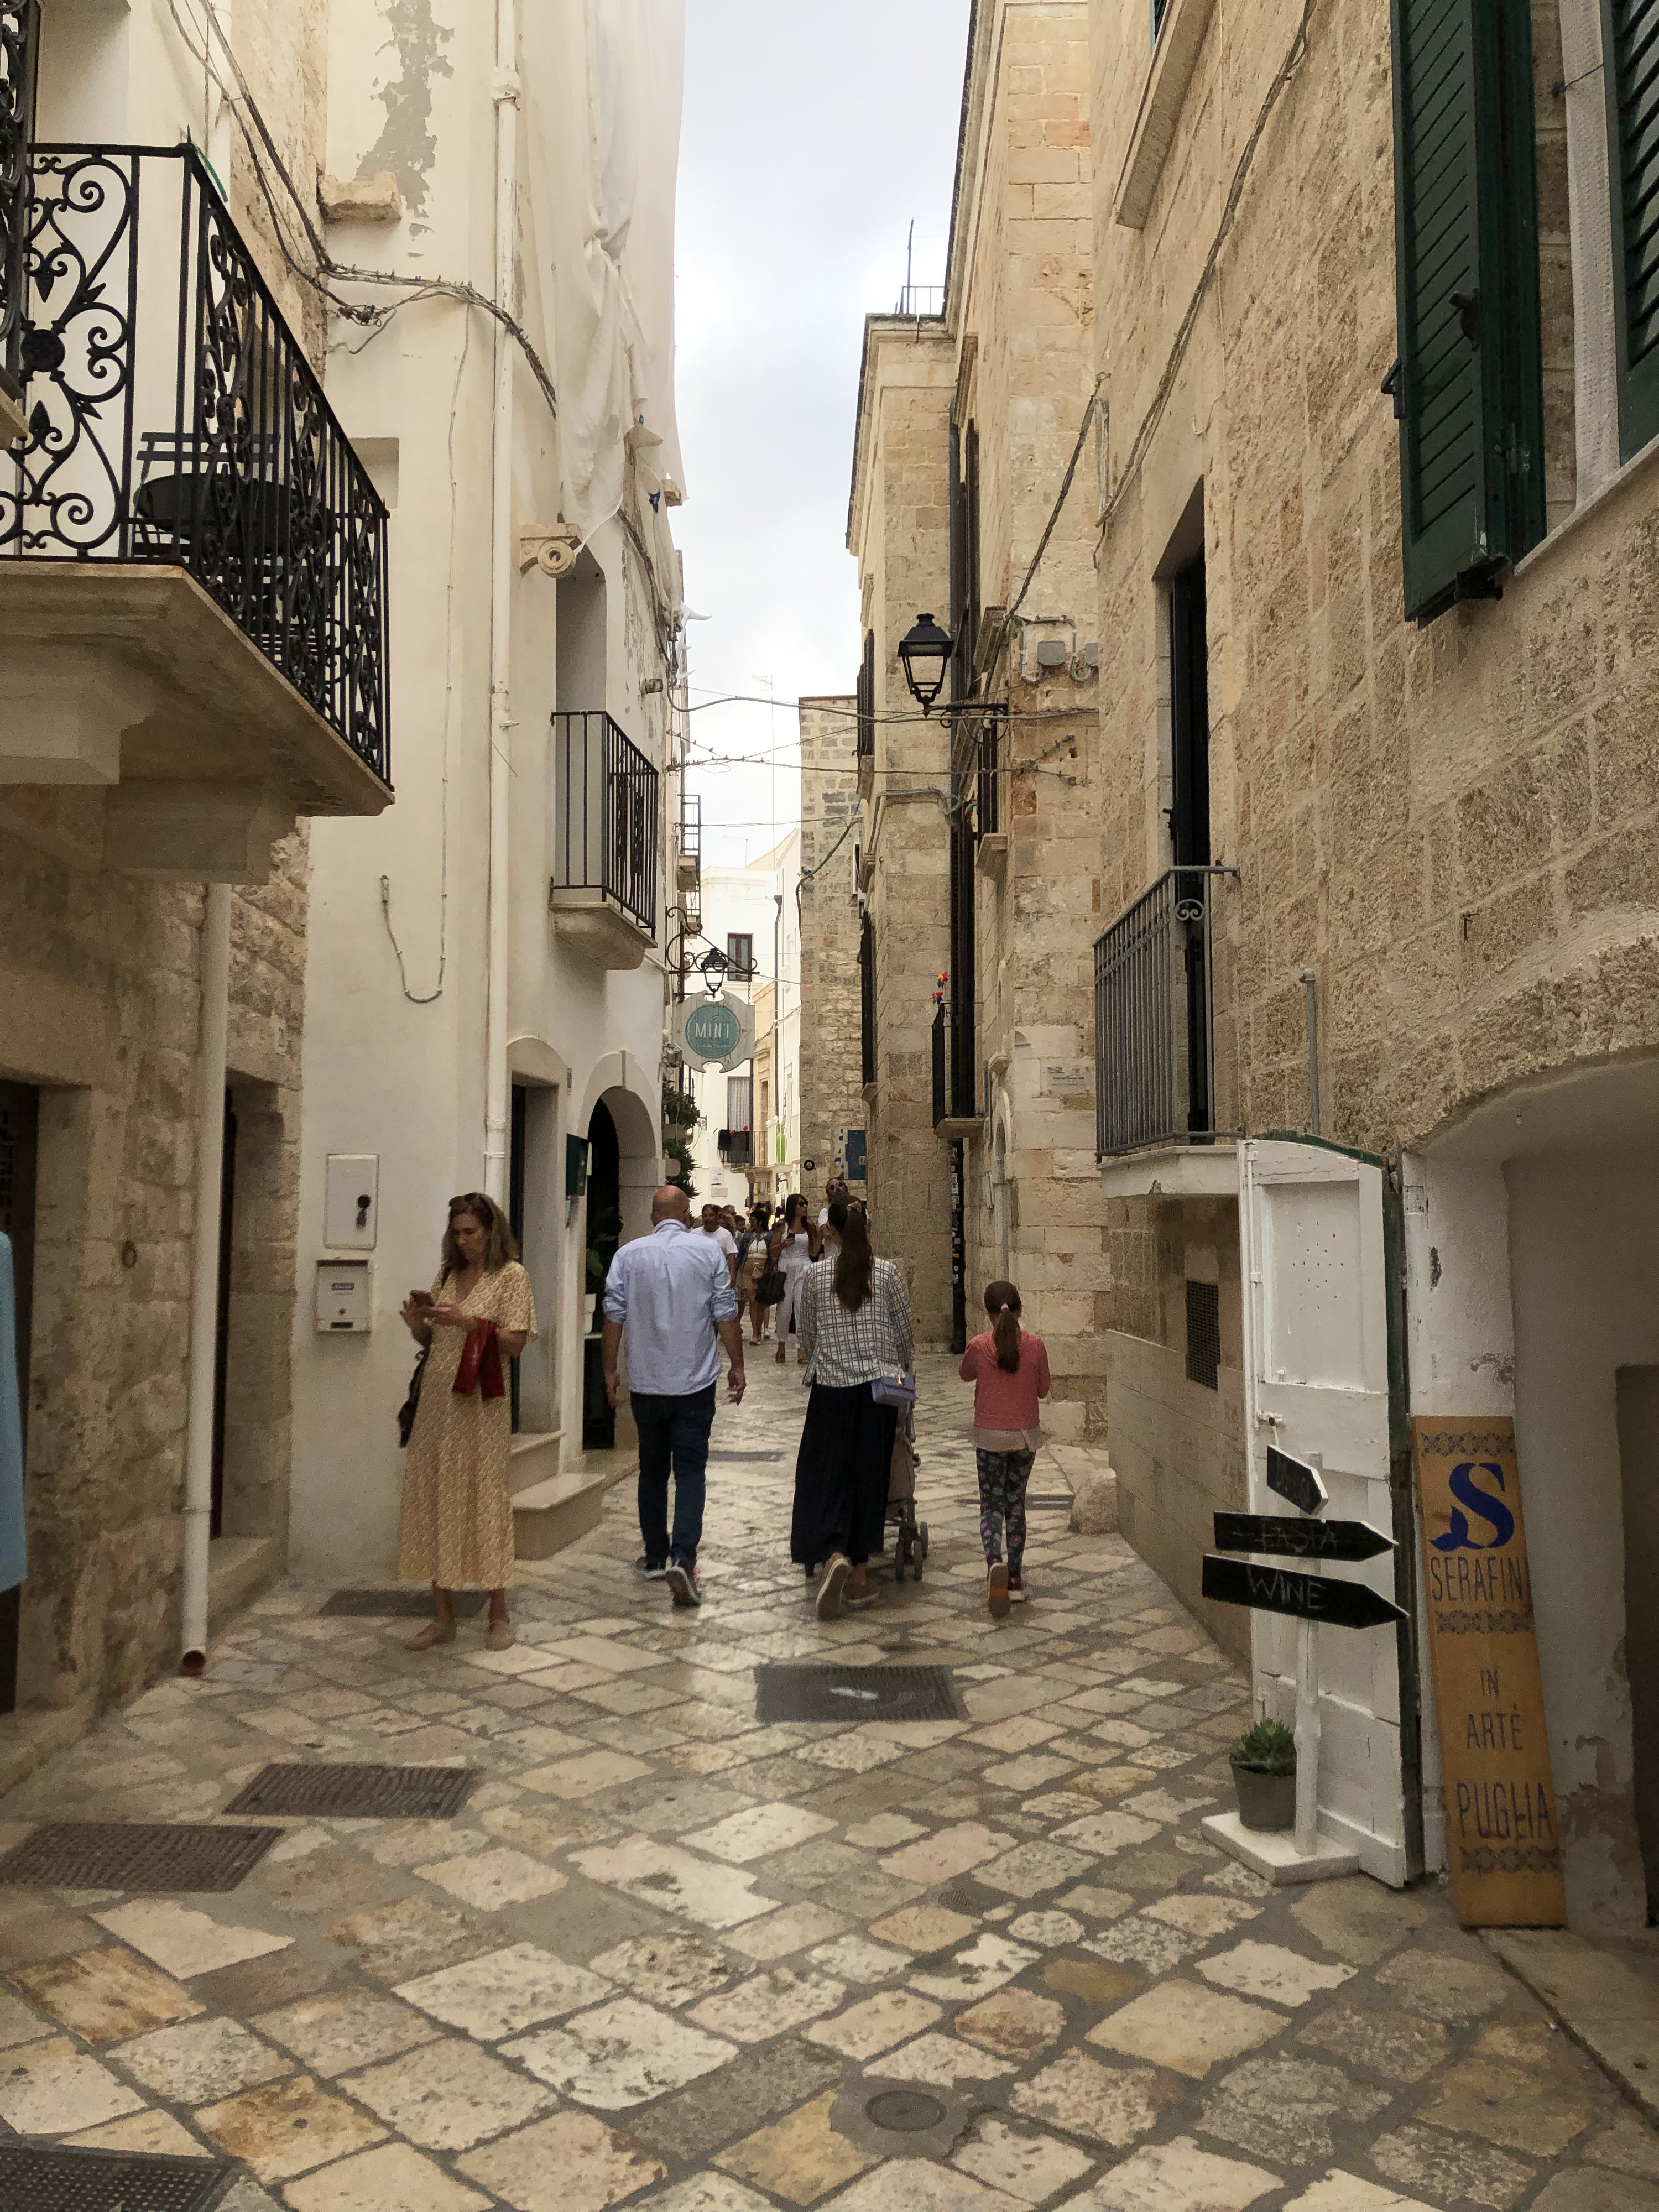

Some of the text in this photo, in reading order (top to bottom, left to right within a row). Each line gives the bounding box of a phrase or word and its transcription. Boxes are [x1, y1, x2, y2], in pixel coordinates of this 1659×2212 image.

[695, 1022, 732, 1038] MINT
[1246, 1563, 1327, 1609] WINE
[1480, 1668, 1499, 1698] IN
[1457, 1781, 1553, 1840] PUGLIA
